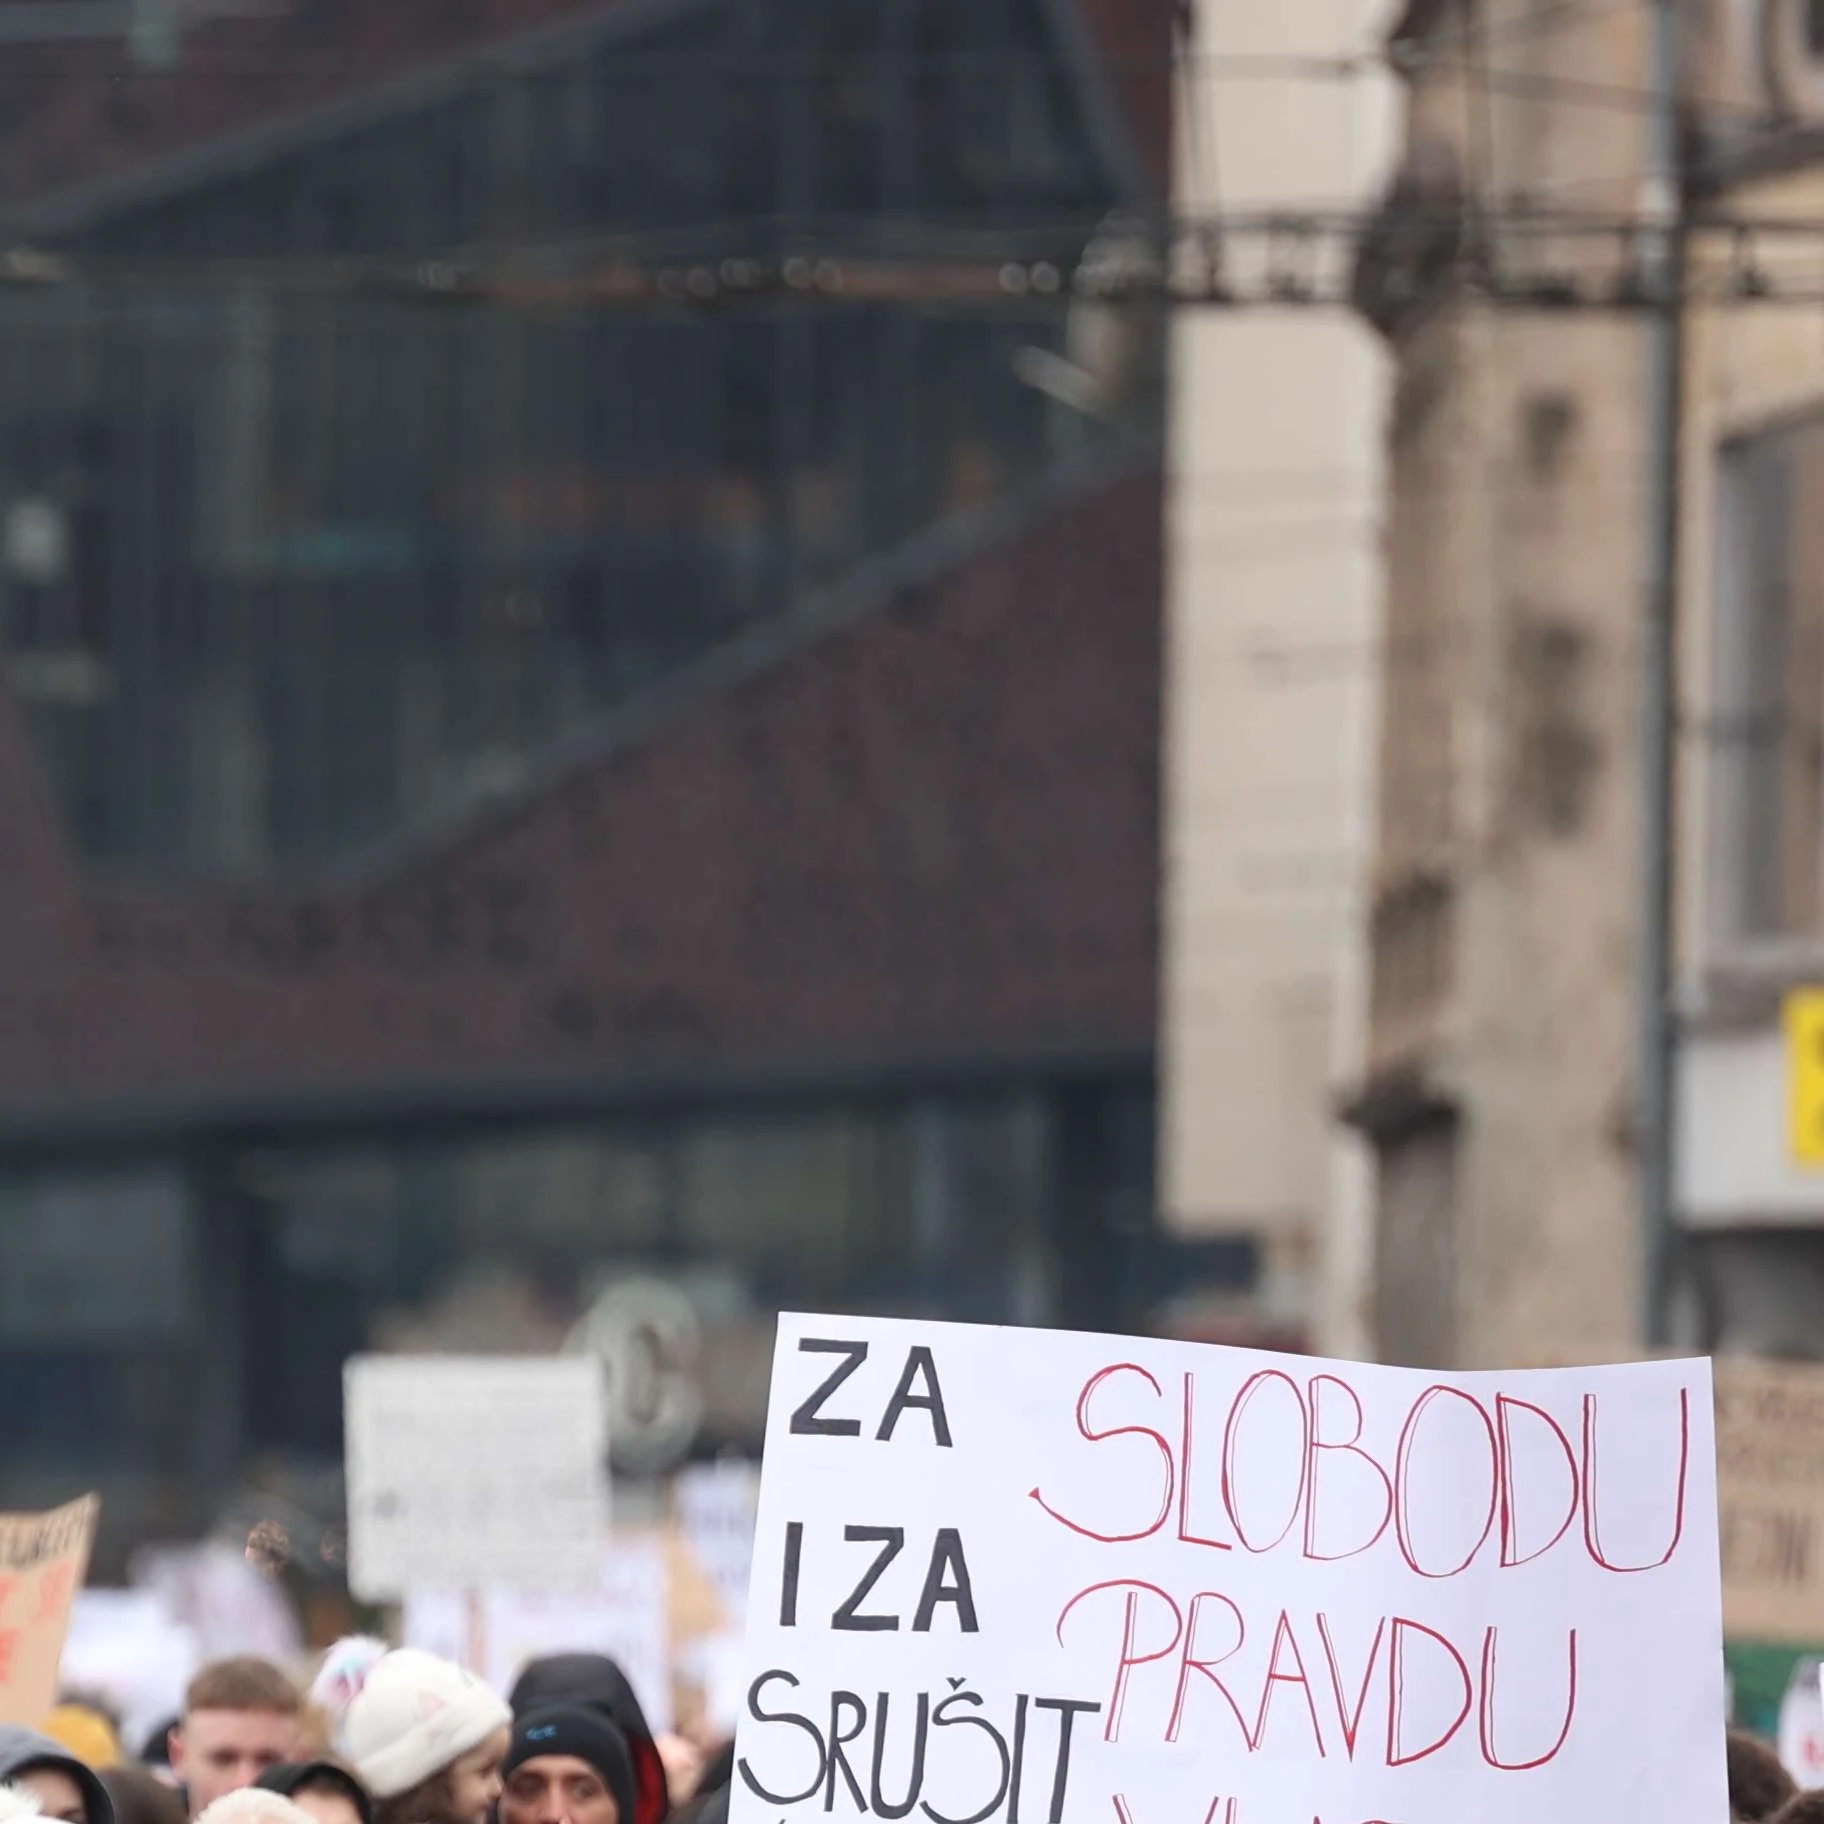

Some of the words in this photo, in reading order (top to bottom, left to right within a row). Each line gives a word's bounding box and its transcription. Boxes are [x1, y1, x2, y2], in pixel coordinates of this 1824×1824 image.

[787, 1338, 954, 1448] ZA
[1027, 1363, 1689, 1578] SLOBODU
[779, 1521, 803, 1628] I
[830, 1524, 981, 1634] ZA
[1055, 1578, 1578, 1771] PRAVDU
